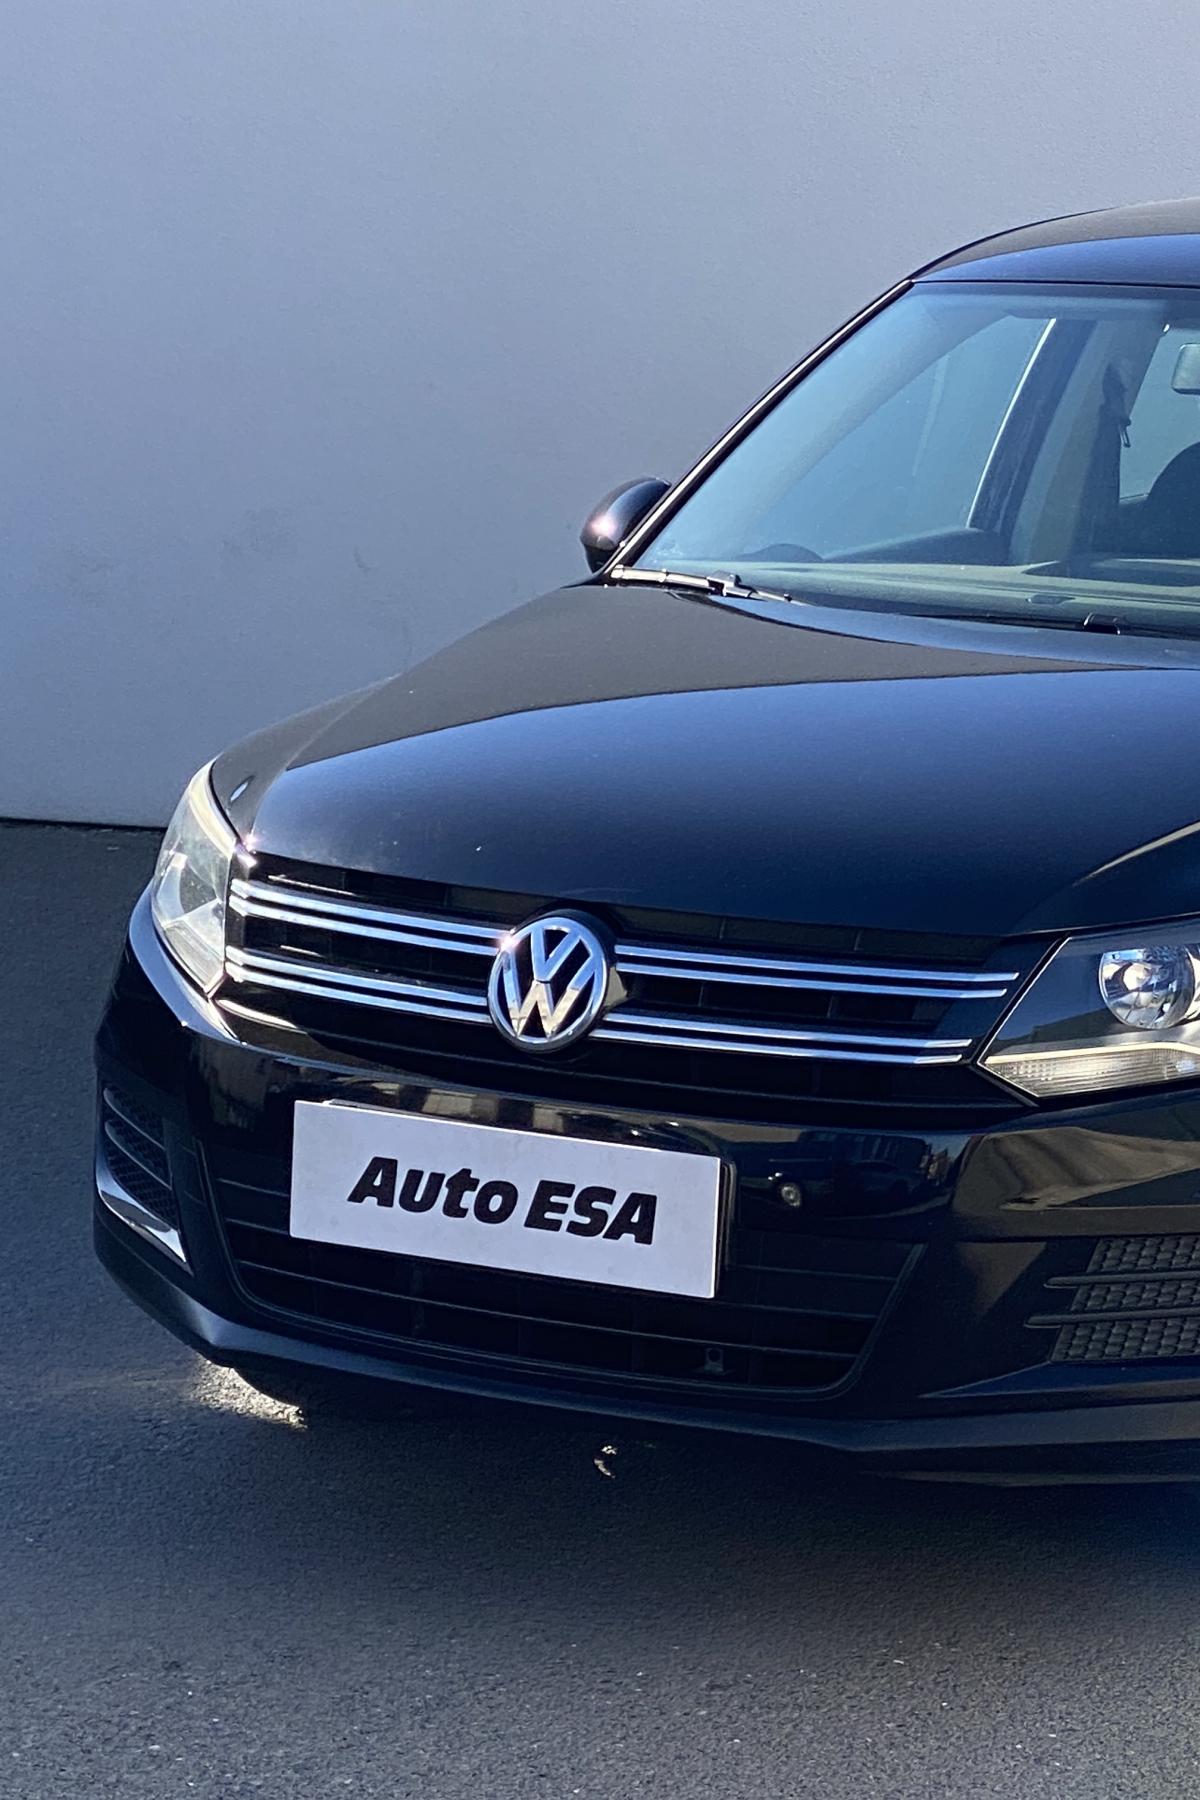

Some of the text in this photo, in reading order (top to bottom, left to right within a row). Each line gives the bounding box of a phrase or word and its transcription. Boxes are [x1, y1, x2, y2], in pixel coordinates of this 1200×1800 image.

[499, 925, 599, 1039] VW
[347, 1156, 658, 1245] Auto ESA
